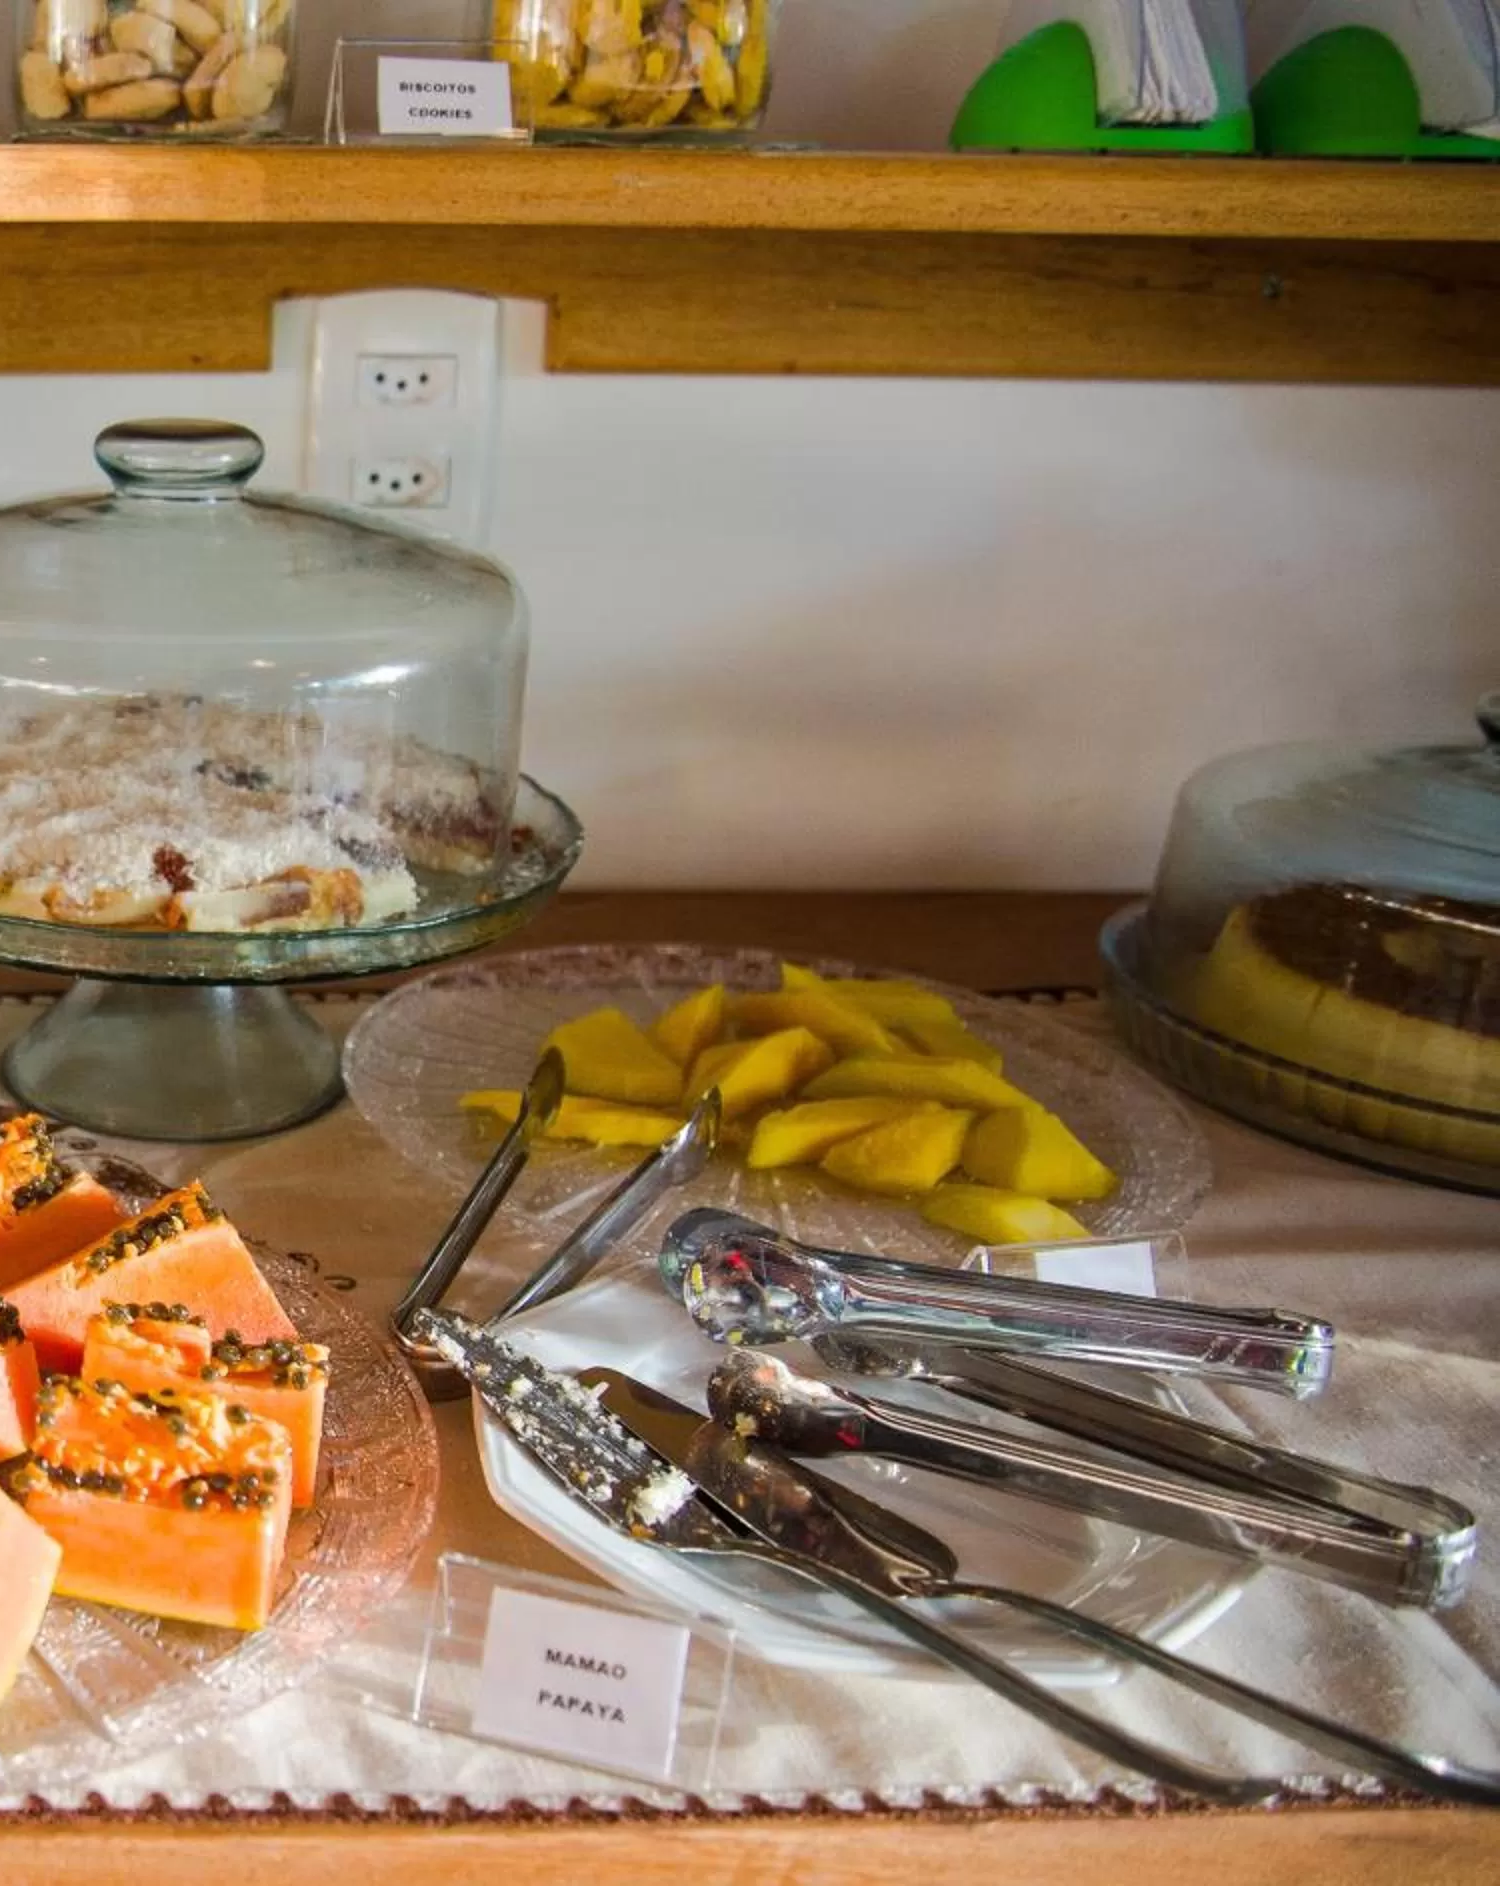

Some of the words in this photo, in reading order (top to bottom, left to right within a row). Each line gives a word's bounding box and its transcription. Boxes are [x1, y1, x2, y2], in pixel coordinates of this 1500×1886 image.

[399, 82, 477, 94] BISCOITOS
[408, 107, 474, 119] COOKIES
[545, 1648, 627, 1681] MAMAO
[536, 1689, 627, 1724] PAPAYA
